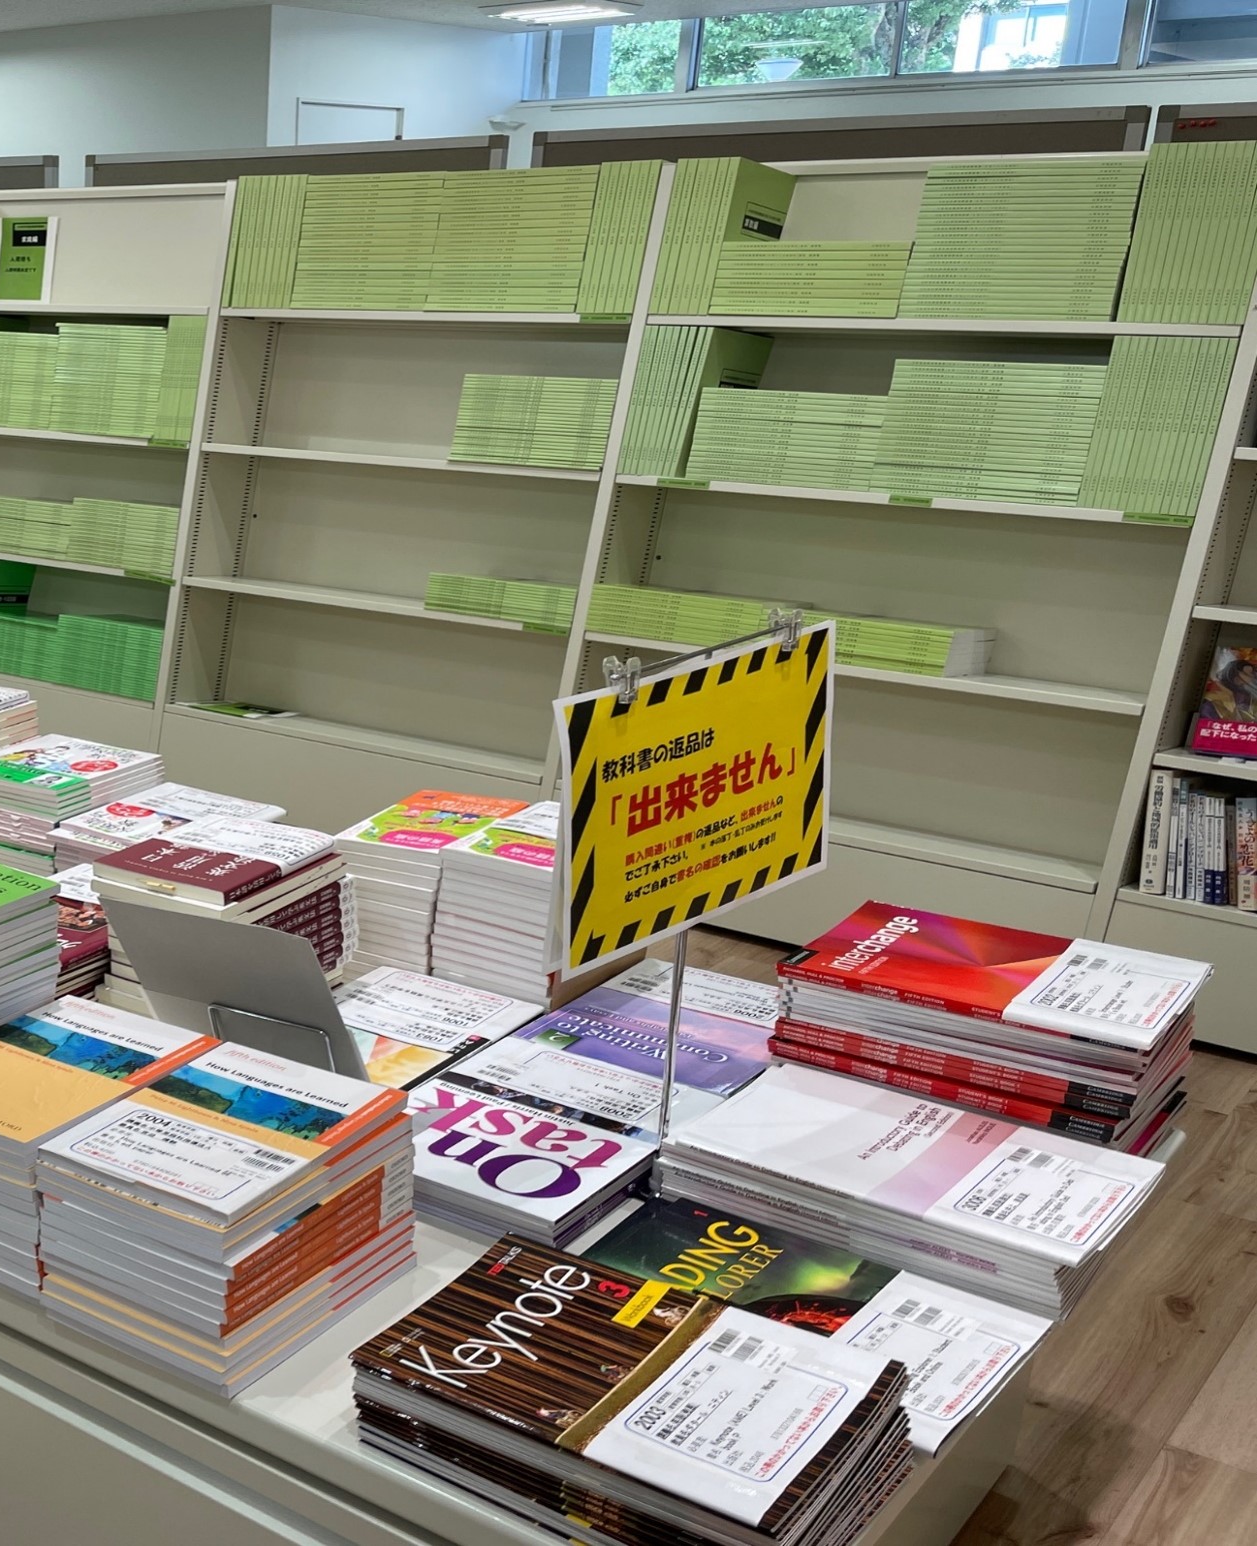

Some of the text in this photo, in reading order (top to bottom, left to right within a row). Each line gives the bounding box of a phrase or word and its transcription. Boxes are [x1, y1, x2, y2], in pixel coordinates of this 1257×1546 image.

[1200, 728, 1257, 742] 配下になった
[602, 727, 715, 784] 教科書の返品は
[610, 742, 798, 838] 「出来ません」
[821, 914, 920, 973] interchange
[861, 983, 898, 995] interchange
[921, 995, 945, 1005] EDITION
[42, 1010, 164, 1053] How Languages are Learned
[548, 1031, 571, 1044] 2
[585, 1027, 667, 1061] Writing
[223, 1048, 287, 1073] fifth edition
[851, 1060, 888, 1075] interchange
[893, 1071, 912, 1080] FIFTH
[911, 1075, 933, 1086] EDITION
[205, 1061, 349, 1109] How Languages are Learned
[440, 1081, 484, 1101] Leeming
[484, 1095, 506, 1109] Paul
[513, 1102, 544, 1119] Harris
[599, 1105, 632, 1120] 2008
[136, 1112, 173, 1129] 2004
[410, 1087, 622, 1170] task
[543, 1111, 575, 1127] Justin
[885, 1131, 914, 1154] Debating
[917, 1107, 943, 1131] English
[855, 1150, 870, 1161] An
[865, 1122, 904, 1157] Introductory
[898, 1110, 918, 1129] Guide
[428, 1129, 581, 1198] On
[761, 1166, 788, 1179] Debating
[795, 1176, 817, 1188] English
[694, 1209, 708, 1217] 1
[659, 1221, 760, 1287] DING
[597, 1279, 632, 1300] 3
[398, 1264, 592, 1390] Keynote
[633, 1406, 668, 1432] 2003
